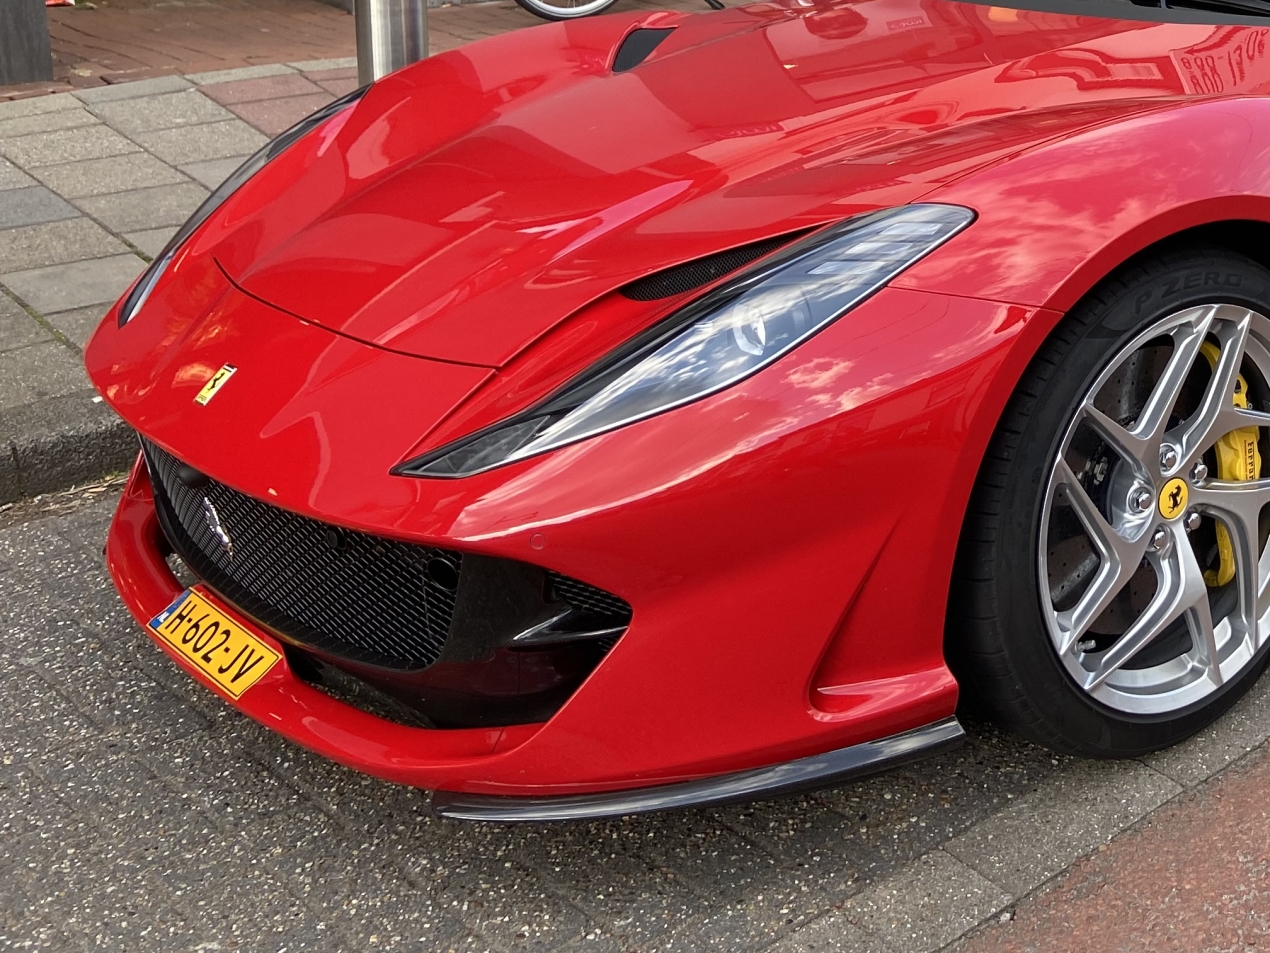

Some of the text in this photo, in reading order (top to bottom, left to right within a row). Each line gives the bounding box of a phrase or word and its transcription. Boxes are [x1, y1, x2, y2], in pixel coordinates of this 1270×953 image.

[1134, 271, 1244, 315] P ZERO
[164, 600, 265, 683] H-602-JV
